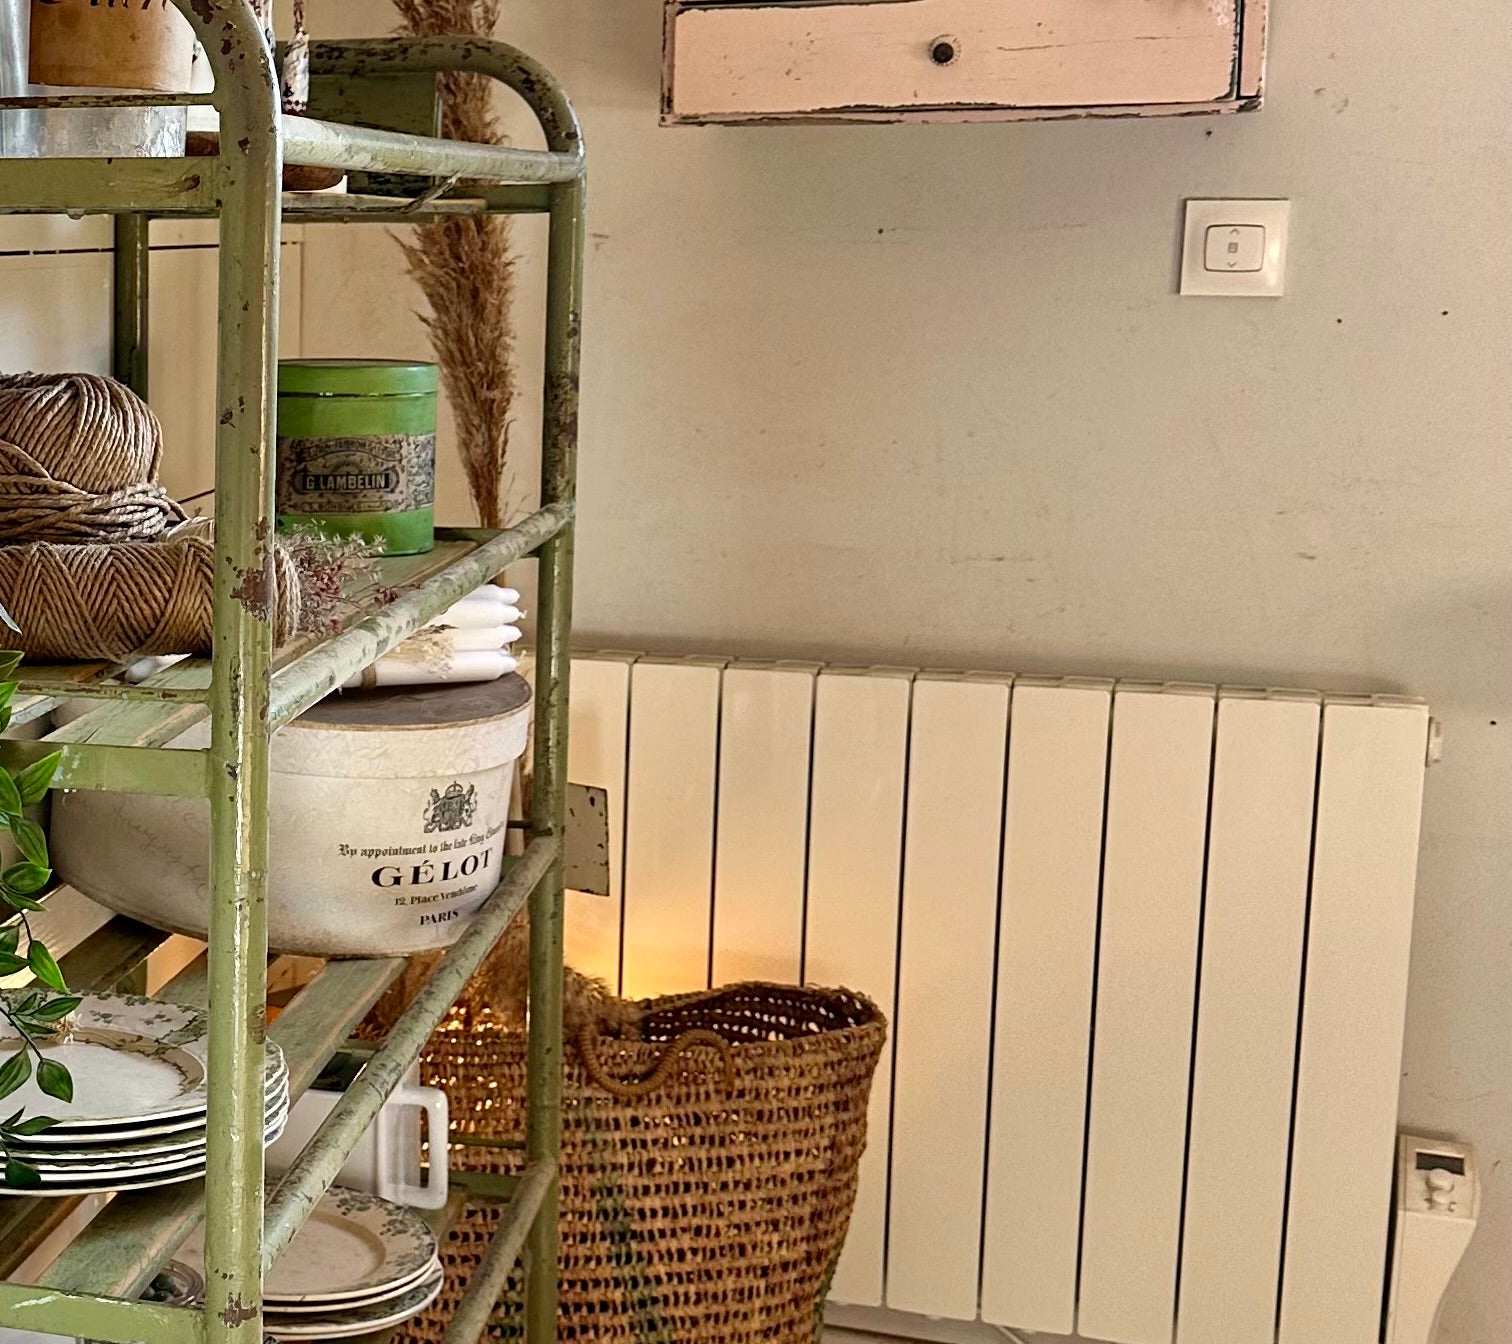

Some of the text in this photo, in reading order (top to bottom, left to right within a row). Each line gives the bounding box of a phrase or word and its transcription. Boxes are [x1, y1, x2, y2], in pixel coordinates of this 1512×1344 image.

[319, 474, 386, 490] LAMBELIN
[338, 843, 358, 858] By
[360, 846, 427, 859] appointment
[429, 844, 438, 854] to
[440, 840, 452, 852] the
[371, 847, 494, 888] GÉLOT
[410, 895, 439, 905] Place
[420, 910, 458, 925] PARIS
